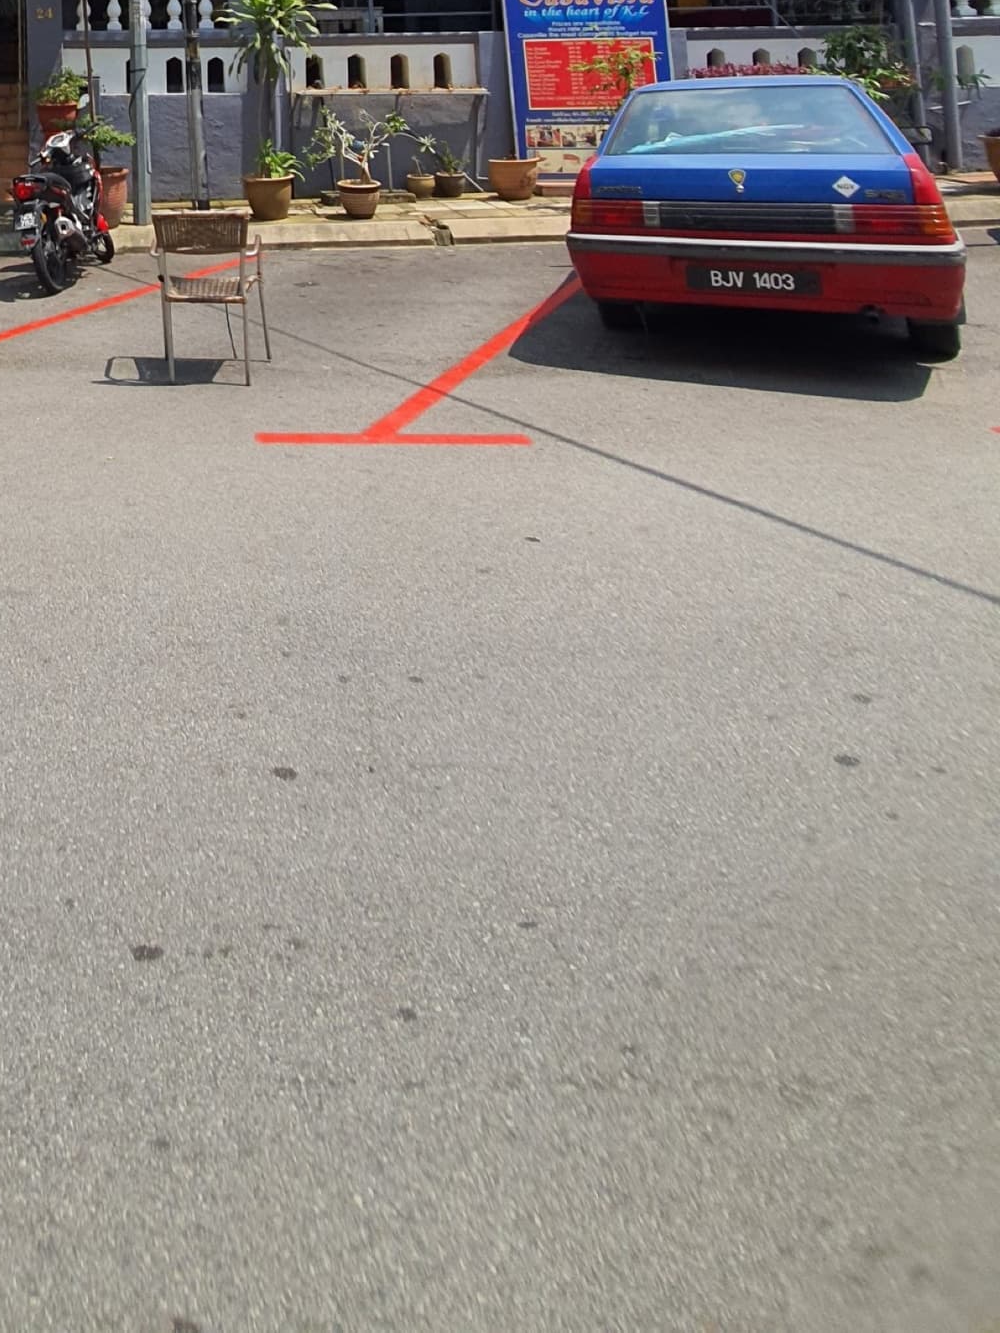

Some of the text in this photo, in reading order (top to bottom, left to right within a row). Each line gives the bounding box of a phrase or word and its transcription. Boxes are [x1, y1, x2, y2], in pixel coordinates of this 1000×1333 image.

[523, 7, 537, 18] in
[541, 5, 562, 17] the
[566, 4, 600, 17] heart
[603, 4, 620, 18] of
[710, 270, 795, 290] BJV 1403
